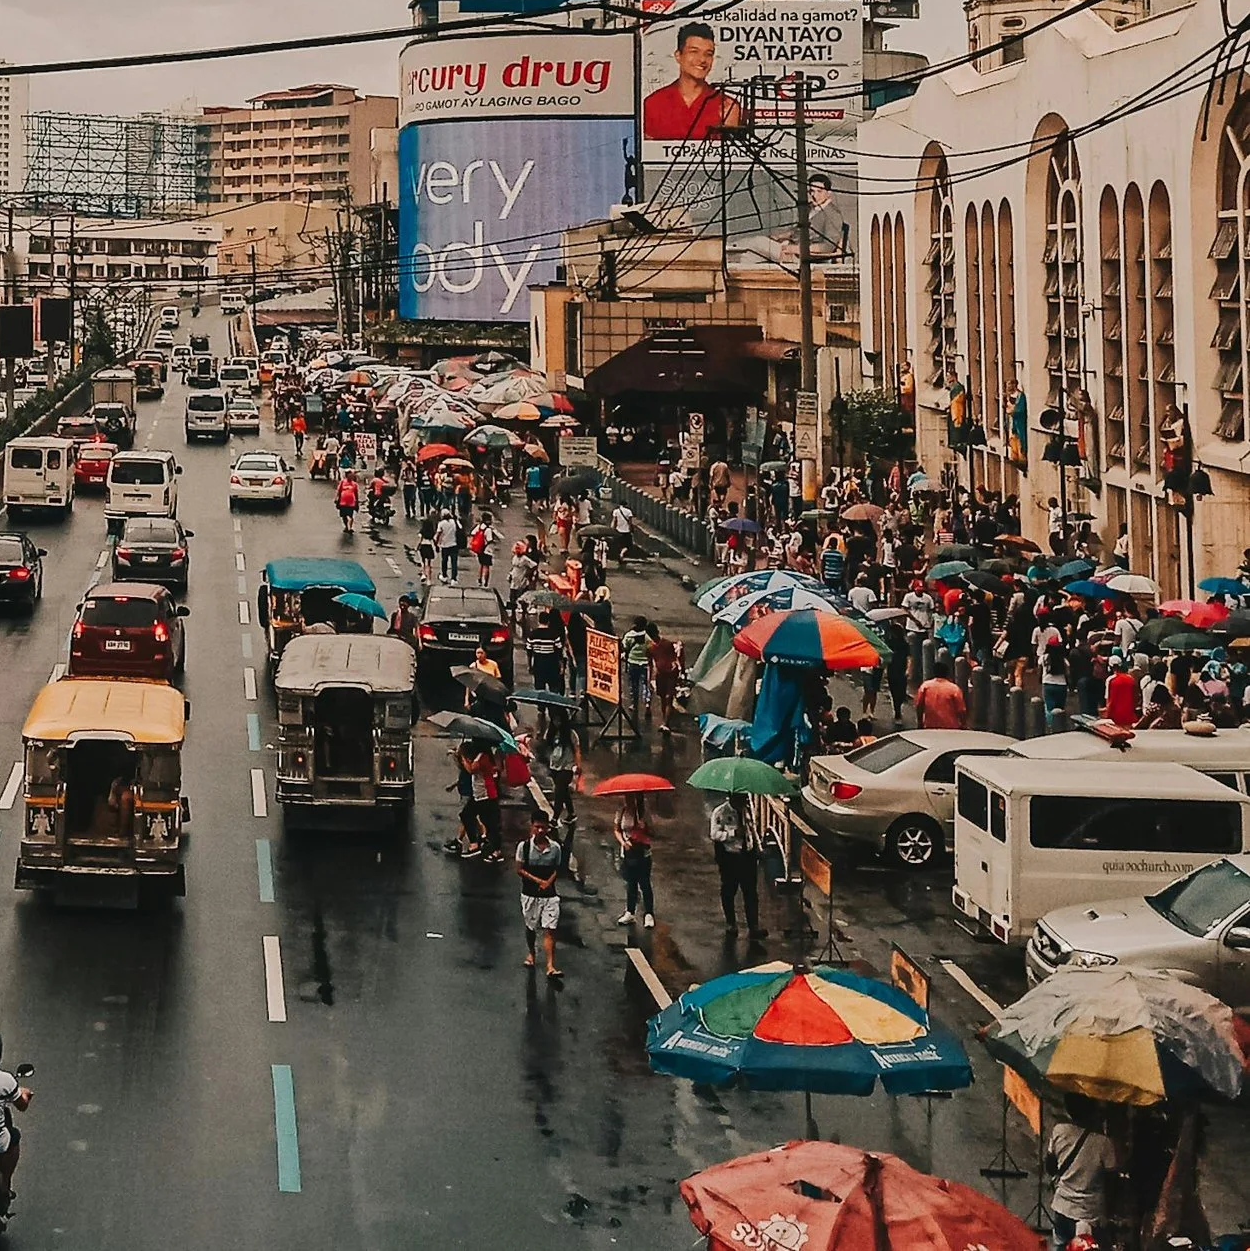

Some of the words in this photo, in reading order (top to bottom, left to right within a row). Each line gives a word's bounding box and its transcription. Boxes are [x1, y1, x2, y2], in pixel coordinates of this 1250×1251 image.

[703, 8, 777, 22] Dekalidad
[781, 11, 799, 22] na
[802, 8, 858, 25] gamot?
[720, 26, 784, 43] DIYAN
[787, 26, 843, 43] TAYO
[734, 44, 761, 61] SA
[763, 44, 833, 61] TAPAT!
[502, 54, 612, 94] drug
[425, 98, 460, 111] GAMOT
[461, 97, 478, 108] AY
[480, 95, 533, 107] LAGING
[536, 95, 581, 106] BAGO
